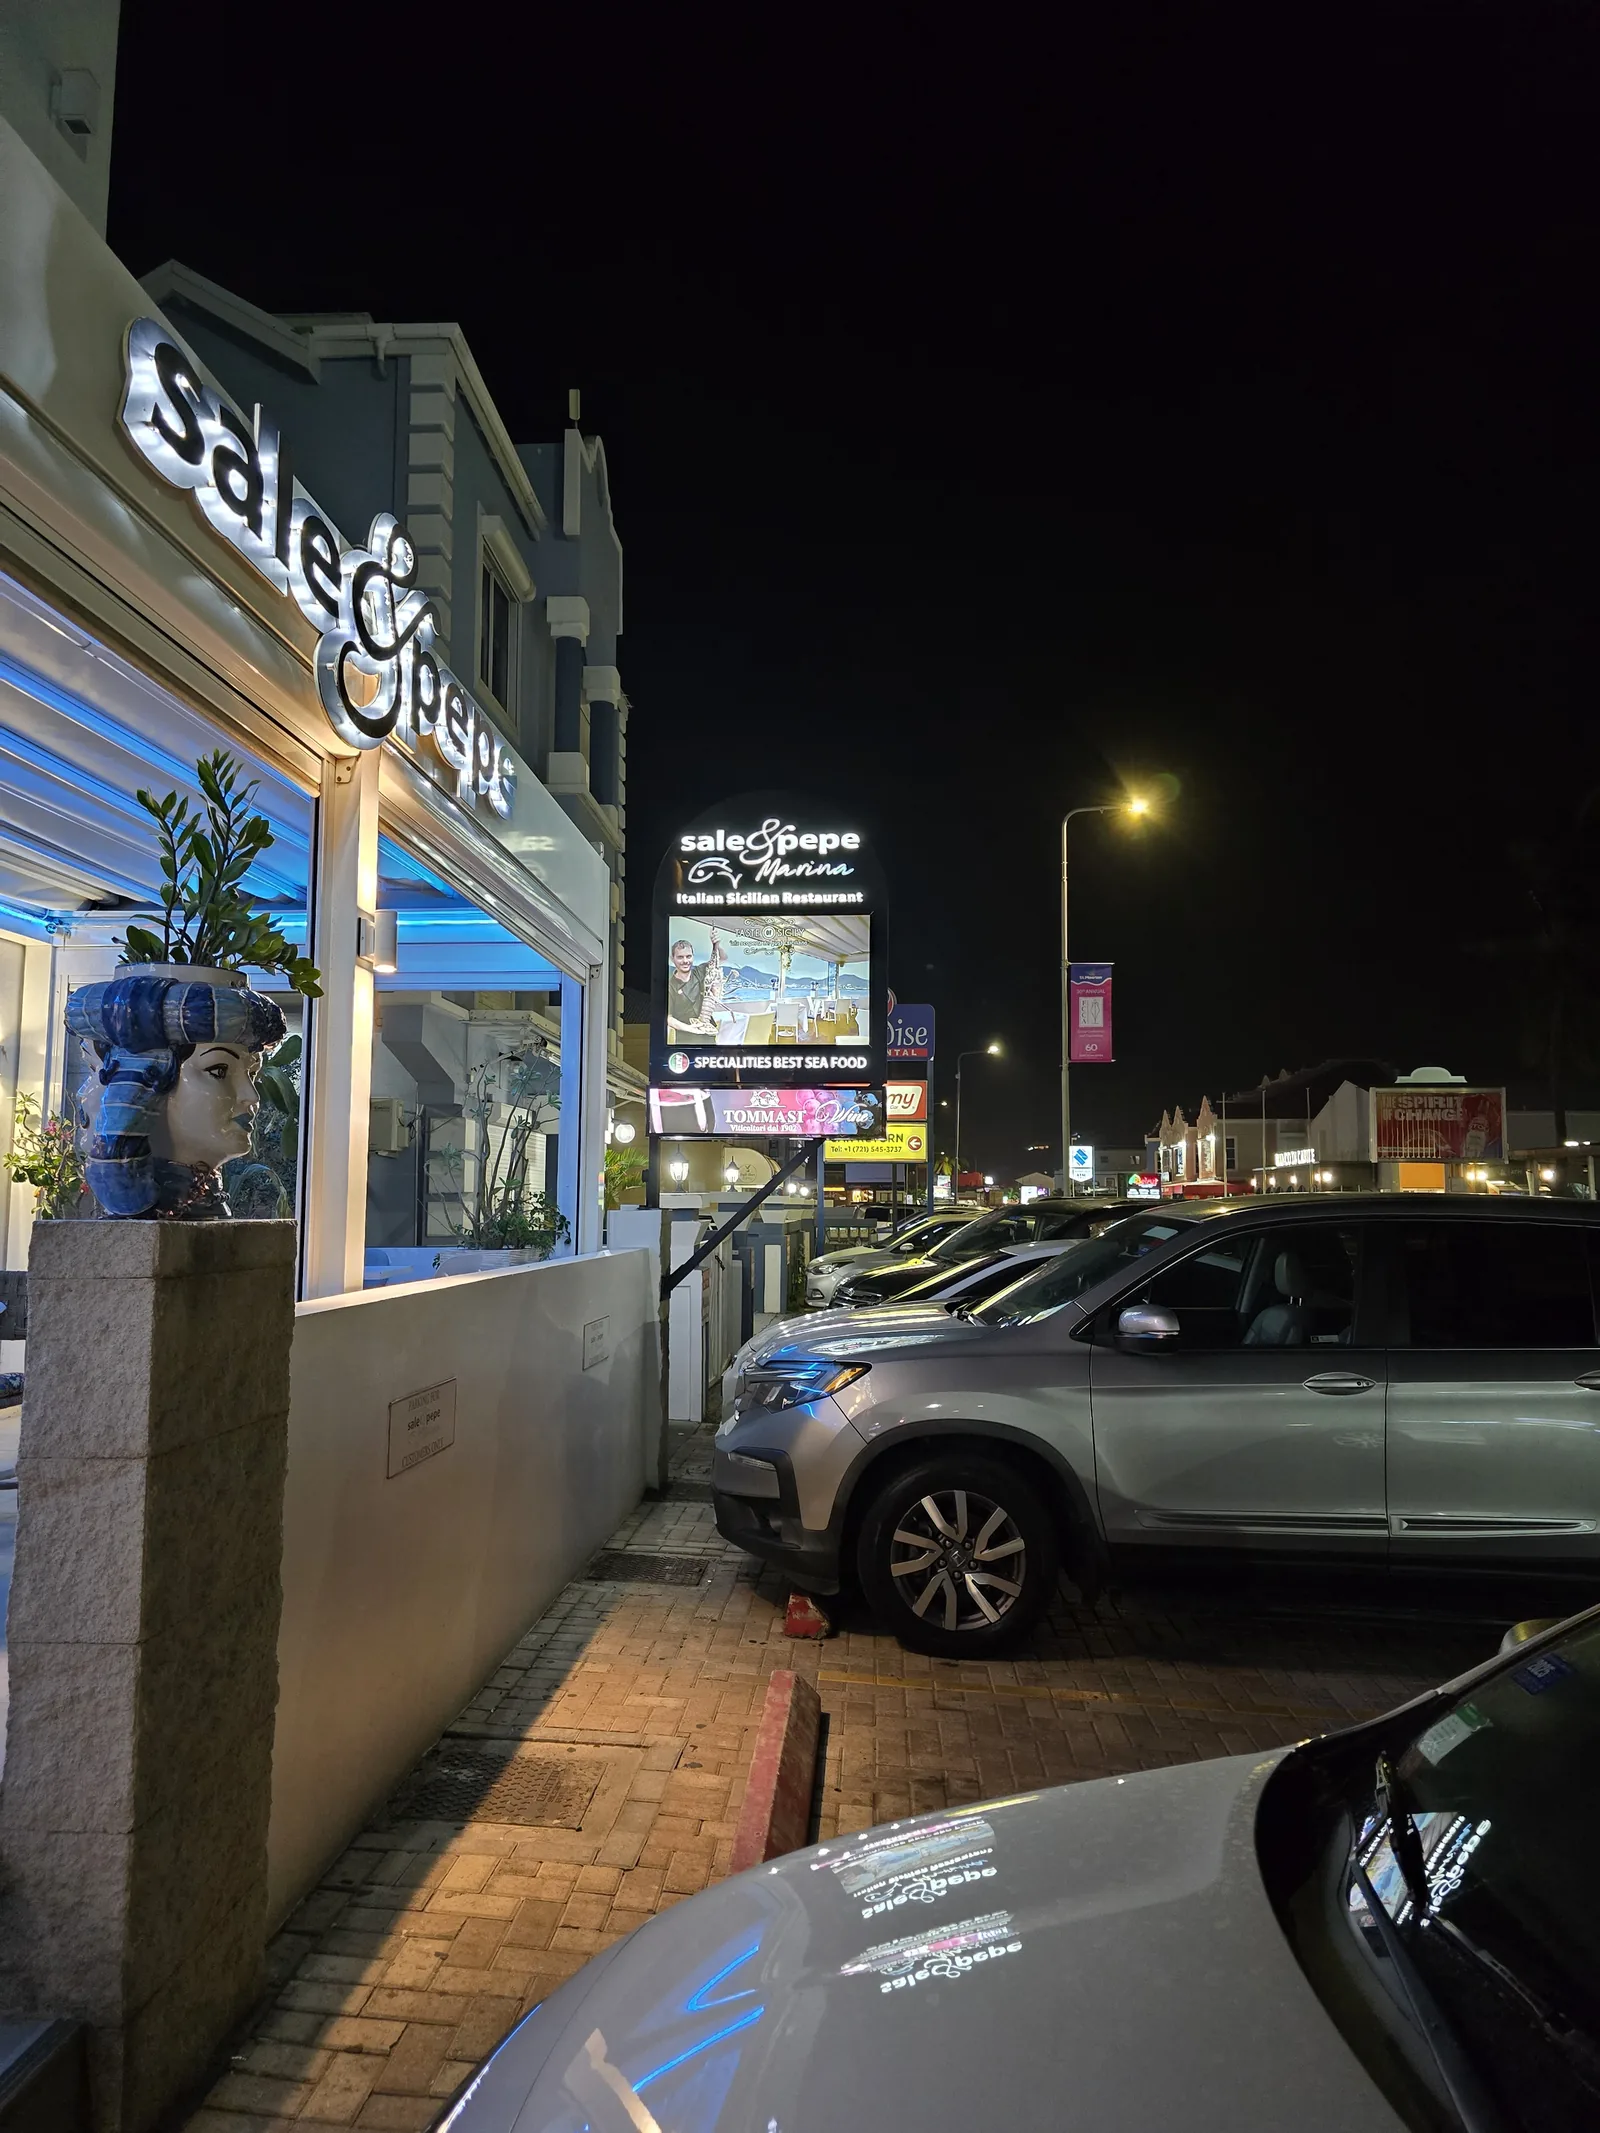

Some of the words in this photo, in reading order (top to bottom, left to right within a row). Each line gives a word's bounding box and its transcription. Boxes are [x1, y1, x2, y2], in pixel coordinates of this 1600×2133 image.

[681, 818, 861, 865] sale&pepe
[755, 858, 855, 885] Marina
[676, 892, 724, 905] Italian
[726, 892, 780, 905] Sicilian
[782, 892, 864, 905] Restaurant
[694, 1055, 772, 1069] SPECIALITIES
[775, 1055, 804, 1069] BEST
[805, 1055, 829, 1069] SEA
[831, 1055, 868, 1069] FOOD
[1400, 1096, 1462, 1108] SPIRIT
[723, 1109, 806, 1124] TOMMASI
[815, 1100, 869, 1124] Wine
[1395, 1109, 1463, 1121] CHANGE
[768, 1124, 780, 1132] dal
[781, 1124, 798, 1132] 1902
[852, 1145, 869, 1153] (721)
